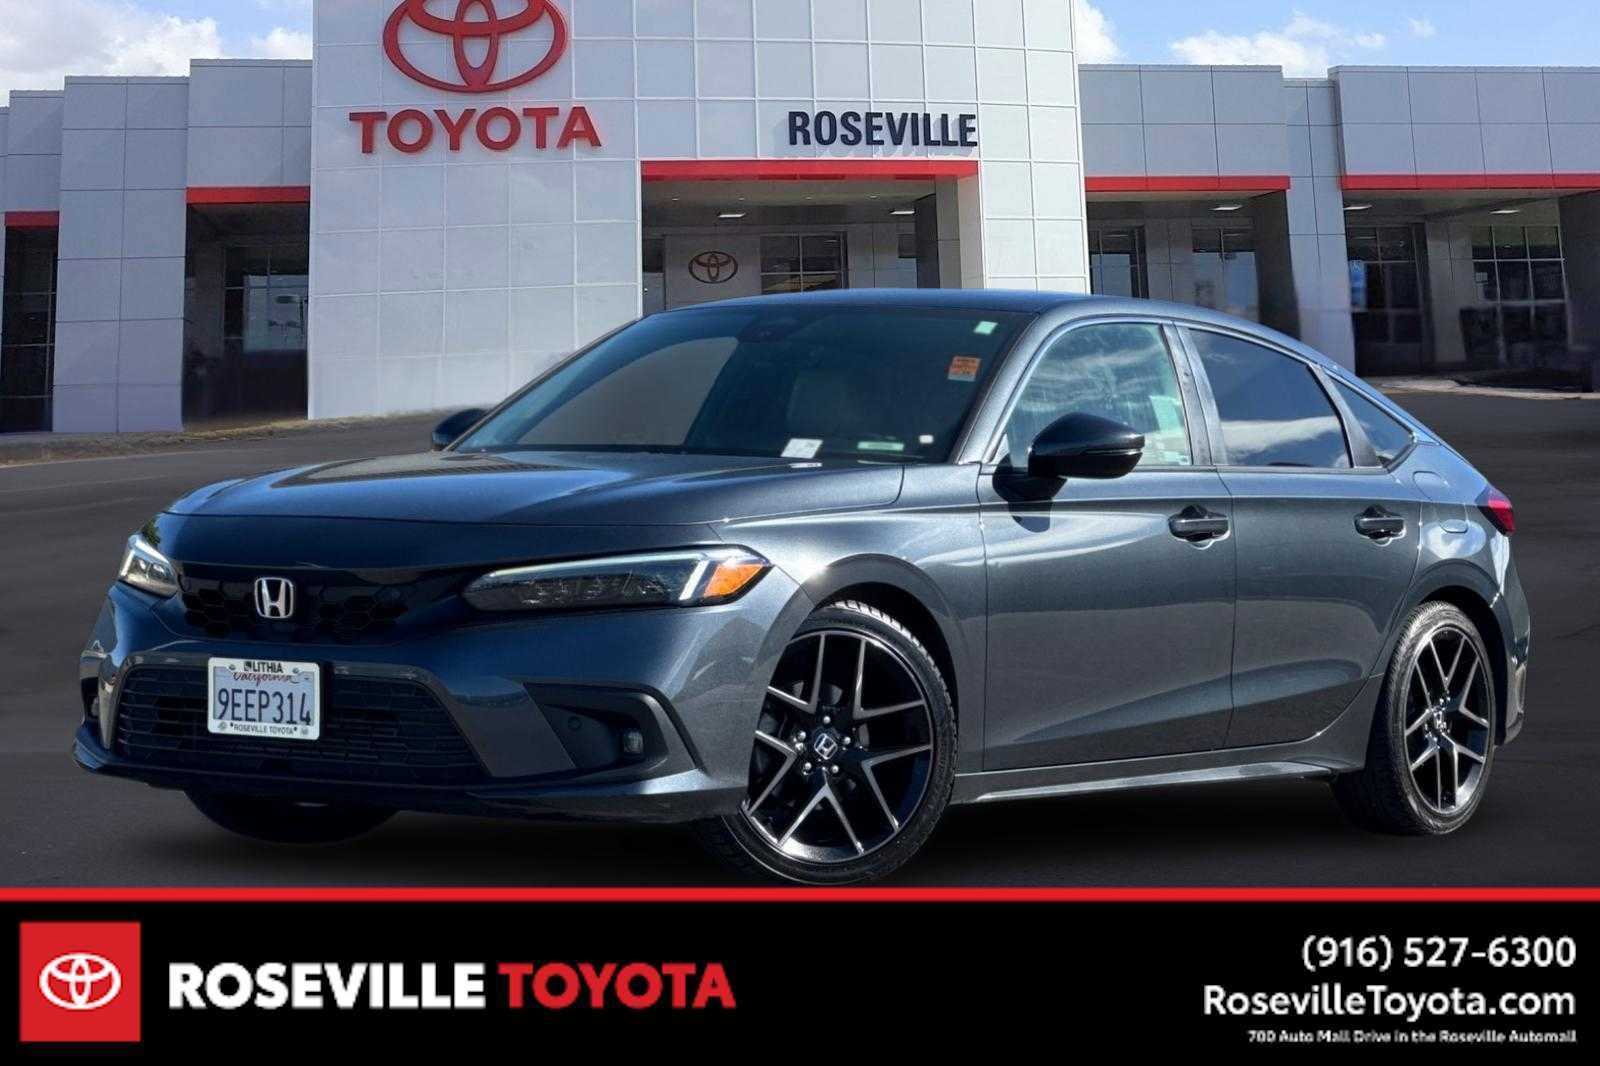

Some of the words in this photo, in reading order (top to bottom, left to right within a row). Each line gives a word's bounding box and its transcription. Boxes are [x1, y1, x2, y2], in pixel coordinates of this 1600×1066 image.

[349, 107, 602, 154] TOYOTA
[788, 110, 978, 147] ROSEVILLE
[253, 661, 283, 673] LITHIA
[218, 688, 311, 725] 9EEP314
[233, 724, 267, 734] ROSEVILLE
[269, 726, 294, 735] TOYOTA
